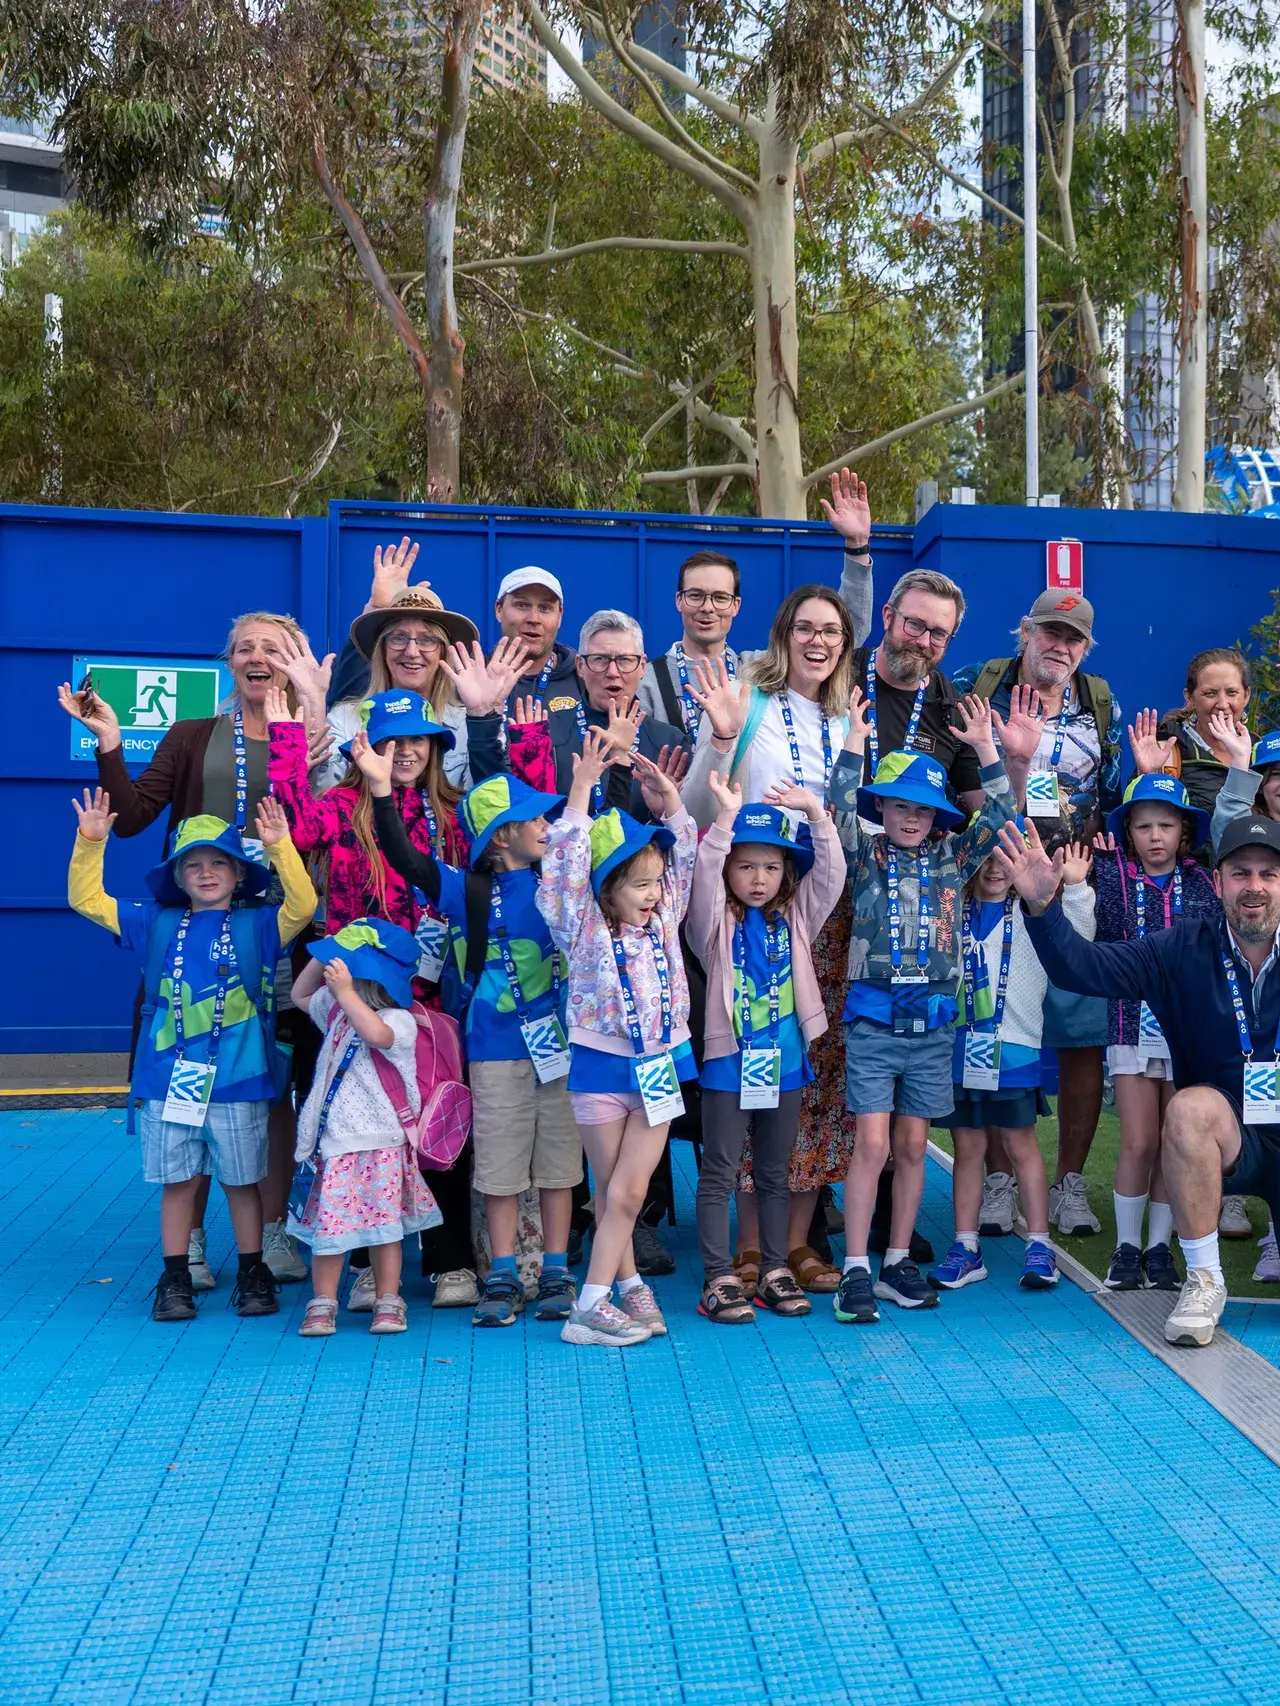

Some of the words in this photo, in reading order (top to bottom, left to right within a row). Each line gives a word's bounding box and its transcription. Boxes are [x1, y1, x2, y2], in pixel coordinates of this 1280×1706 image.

[681, 669, 686, 677] AO
[869, 684, 874, 692] AO
[918, 691, 923, 699] AO
[687, 700, 692, 708] AO
[785, 712, 790, 720] AO
[823, 722, 828, 730] AO
[910, 725, 915, 734] AO
[694, 728, 698, 737] AO
[80, 737, 159, 750] EMENCY
[1055, 744, 1060, 752] AO
[793, 748, 798, 757] AO
[872, 752, 877, 761] AO
[827, 757, 832, 765] AO
[239, 769, 244, 777] AO
[596, 787, 601, 796] AO
[238, 802, 244, 811] AO
[430, 821, 436, 829] AO
[890, 864, 895, 873] AO
[922, 868, 927, 877] AO
[1138, 893, 1143, 902] AO
[1176, 897, 1180, 905] AO
[495, 908, 501, 918] AO
[892, 904, 897, 913] AO
[922, 904, 927, 914] AO
[964, 922, 969, 930] AO
[1006, 924, 1011, 933] AO
[652, 936, 658, 944] AO
[769, 935, 774, 943] AO
[177, 941, 182, 951] AO
[616, 944, 622, 954] AO
[893, 940, 899, 950] AO
[920, 940, 925, 950] AO
[222, 945, 227, 955] AO
[504, 950, 509, 960] AO
[966, 960, 971, 969] AO
[1002, 964, 1007, 973] AO
[662, 976, 667, 986] AO
[772, 973, 777, 983] AO
[175, 984, 179, 993] AO
[554, 979, 559, 989] AO
[218, 987, 224, 997] AO
[514, 988, 520, 997] AO
[624, 988, 630, 998] AO
[1233, 985, 1238, 995] AO
[967, 995, 972, 1005] AO
[998, 999, 1003, 1008] AO
[744, 1010, 749, 1020] AO
[772, 1011, 777, 1021] AO
[664, 1015, 669, 1026] AO
[177, 1022, 181, 1032] AO
[213, 1026, 219, 1036] AO
[1241, 1023, 1246, 1033] AO
[633, 1027, 639, 1037] AO
[346, 1049, 353, 1058] AO
[328, 1090, 333, 1100] AO
